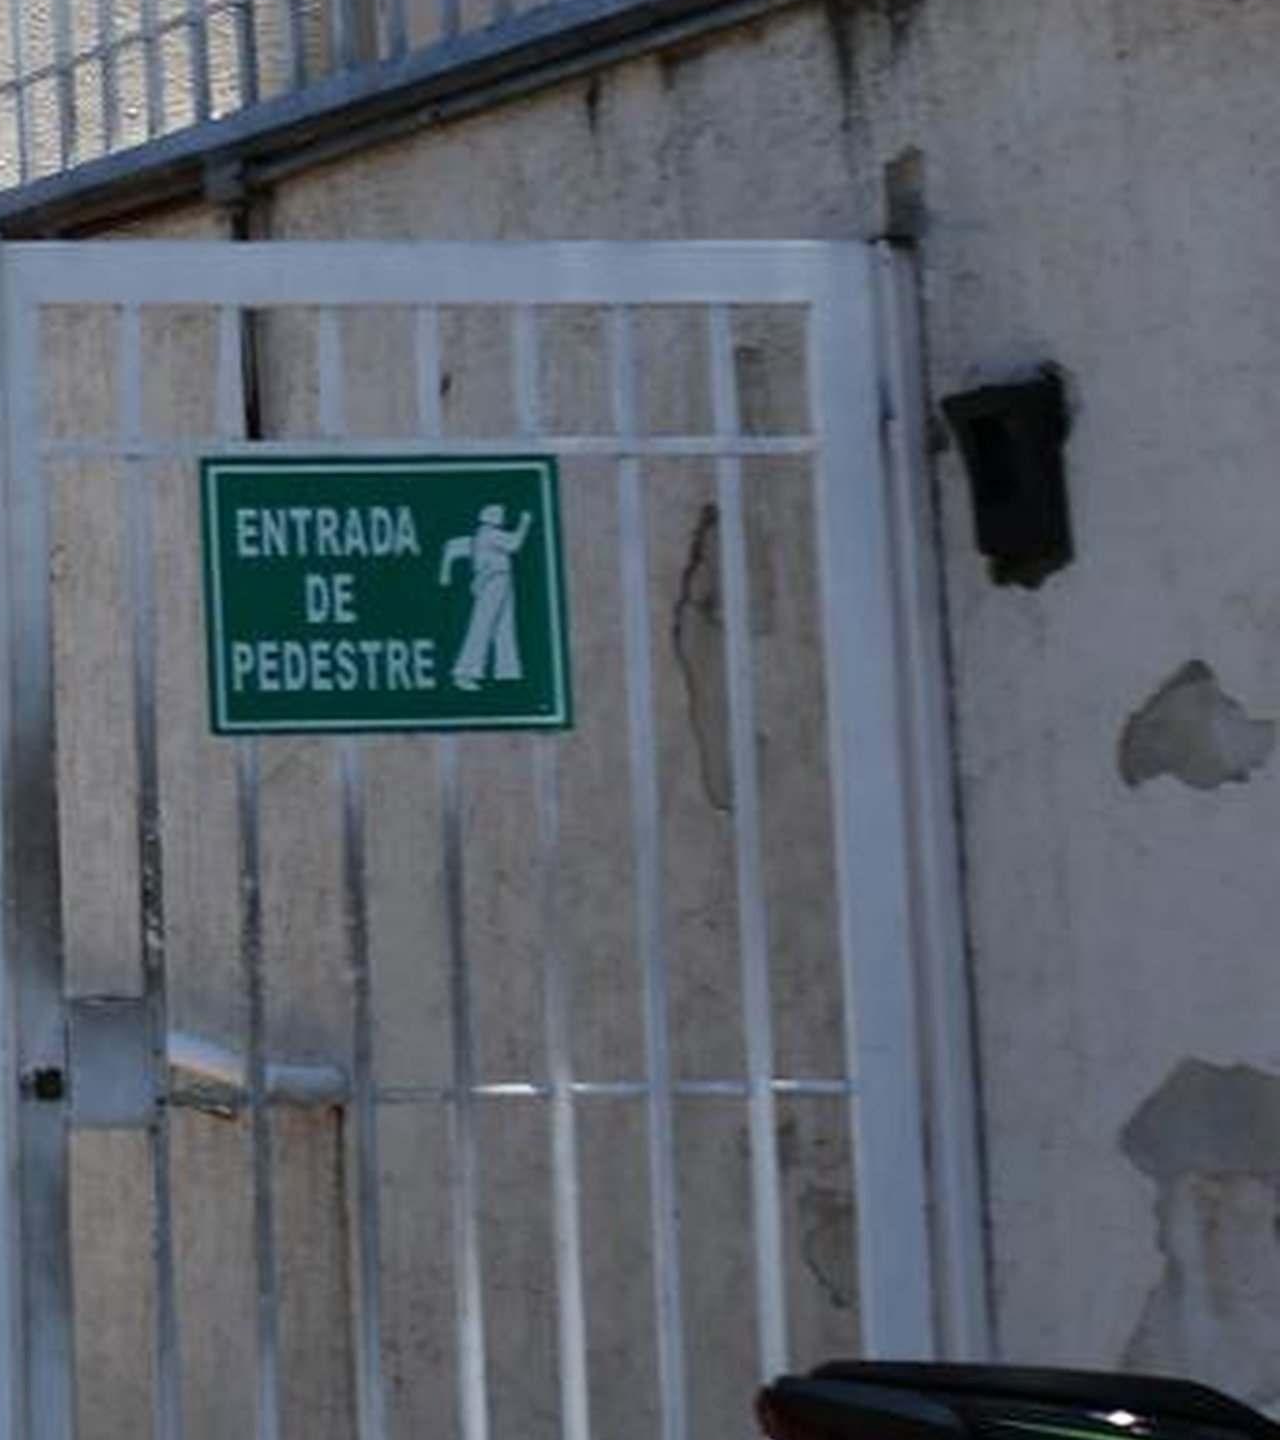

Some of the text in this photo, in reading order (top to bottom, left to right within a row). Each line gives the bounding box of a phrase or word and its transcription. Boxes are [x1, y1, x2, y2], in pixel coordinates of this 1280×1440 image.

[237, 506, 421, 557] ENTRADA
[306, 573, 358, 623] DE
[231, 640, 437, 692] PEDESTRE
